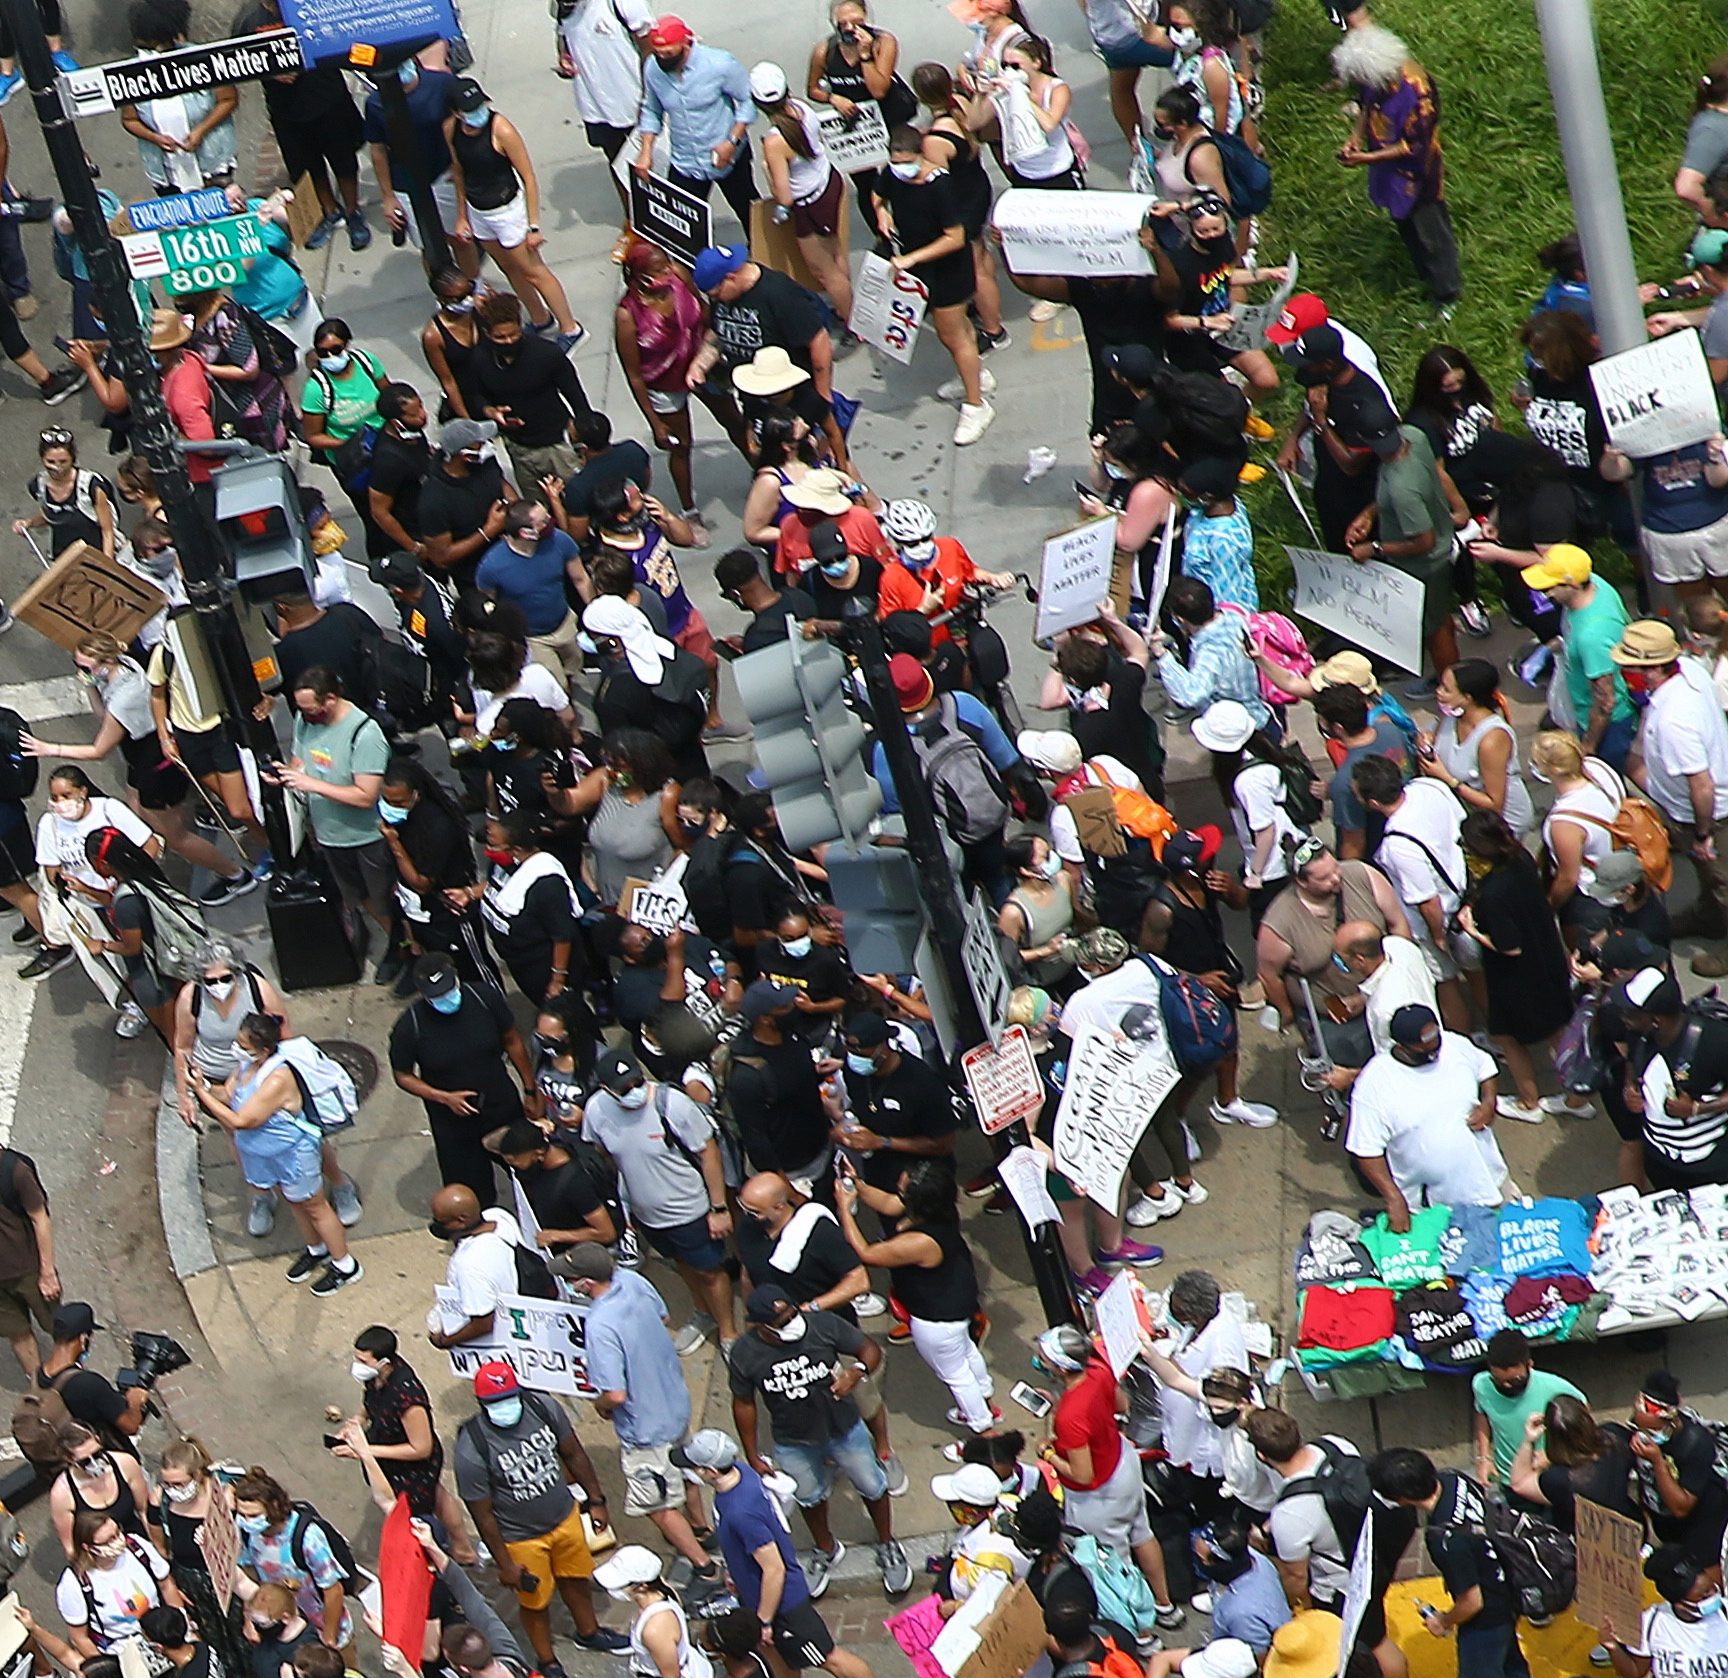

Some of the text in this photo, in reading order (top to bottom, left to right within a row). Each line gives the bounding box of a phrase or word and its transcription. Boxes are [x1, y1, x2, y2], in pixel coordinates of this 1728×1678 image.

[275, 49, 300, 70] NW
[107, 66, 161, 101] Black
[167, 56, 208, 90] Lives
[214, 47, 269, 83] Matter
[132, 191, 227, 229] EVACUATION ROUTE
[636, 177, 700, 223] BLACK LIVES
[168, 221, 255, 265] 16th ST
[238, 236, 262, 256] NW
[171, 264, 237, 292] 800
[1604, 388, 1668, 428] BLACK
[1062, 530, 1099, 554] BLACK
[1062, 550, 1094, 572] LIVES
[1052, 566, 1101, 593] MATTER
[1341, 574, 1390, 614] BLM
[1306, 586, 1394, 646] NO PEACE
[1059, 1035, 1105, 1171] Racism
[1500, 1219, 1560, 1237] BLACK
[1399, 1239, 1411, 1251] I
[1500, 1234, 1560, 1255] LIVES
[1501, 1246, 1564, 1274] MATTER
[763, 1362, 829, 1392] KILLING
[772, 1355, 810, 1377] STOP
[498, 1426, 552, 1471] BLACK
[1658, 1652, 1728, 1675] WE MAD
